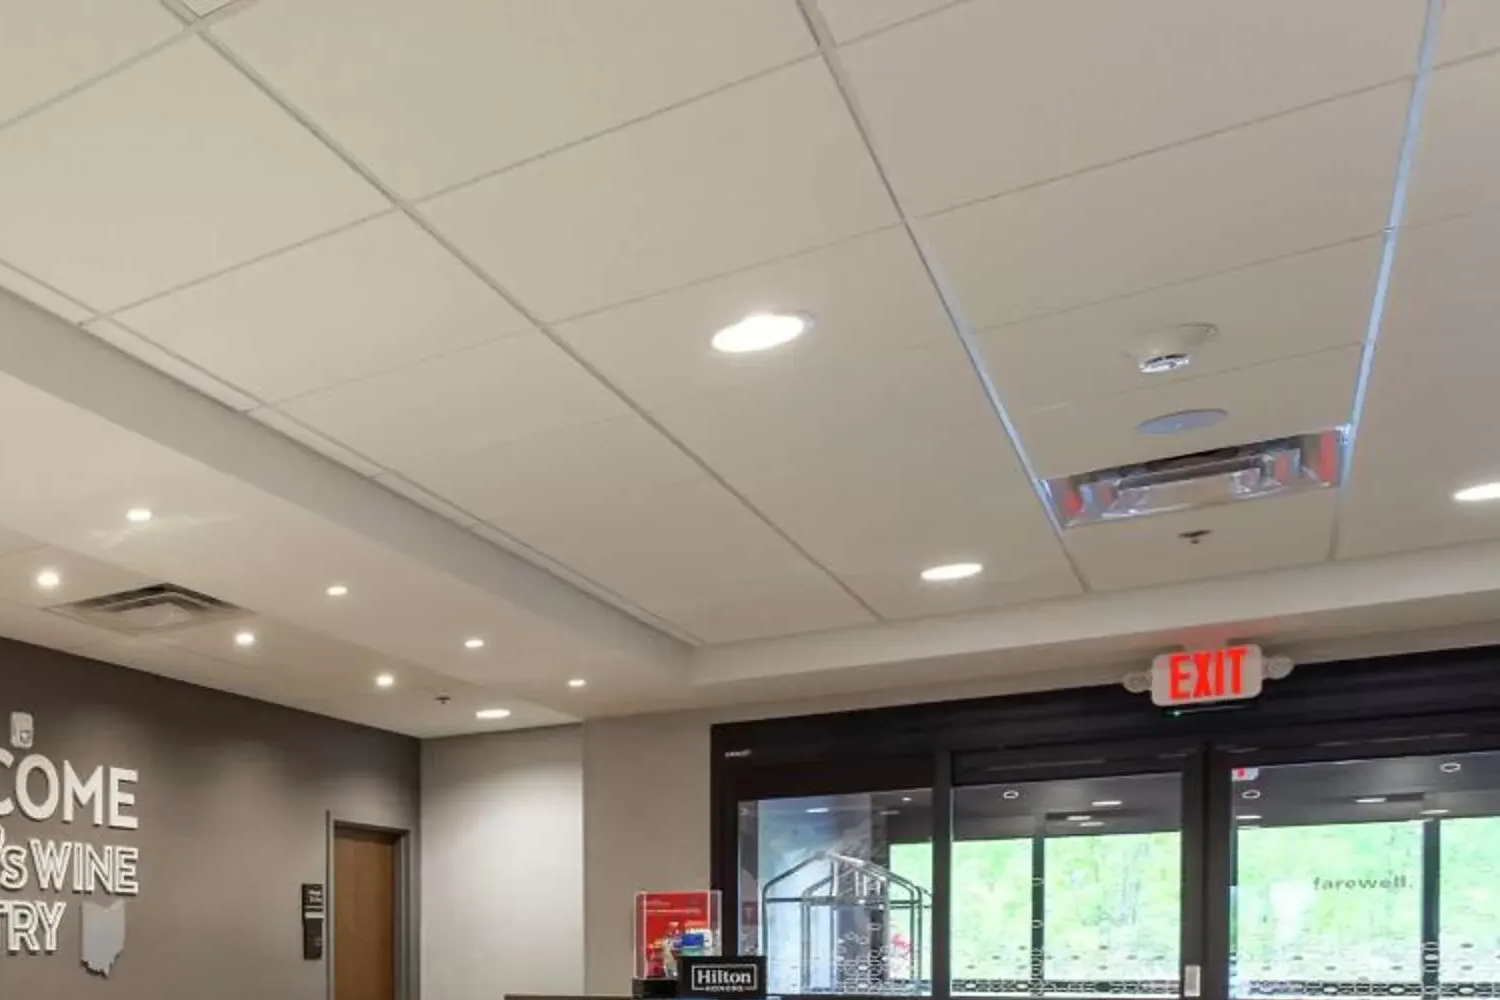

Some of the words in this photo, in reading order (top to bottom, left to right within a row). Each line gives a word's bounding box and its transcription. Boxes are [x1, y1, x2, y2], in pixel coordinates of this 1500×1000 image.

[1169, 646, 1249, 702] EXIT
[29, 838, 139, 896] WINE
[697, 969, 751, 985] Hilton
